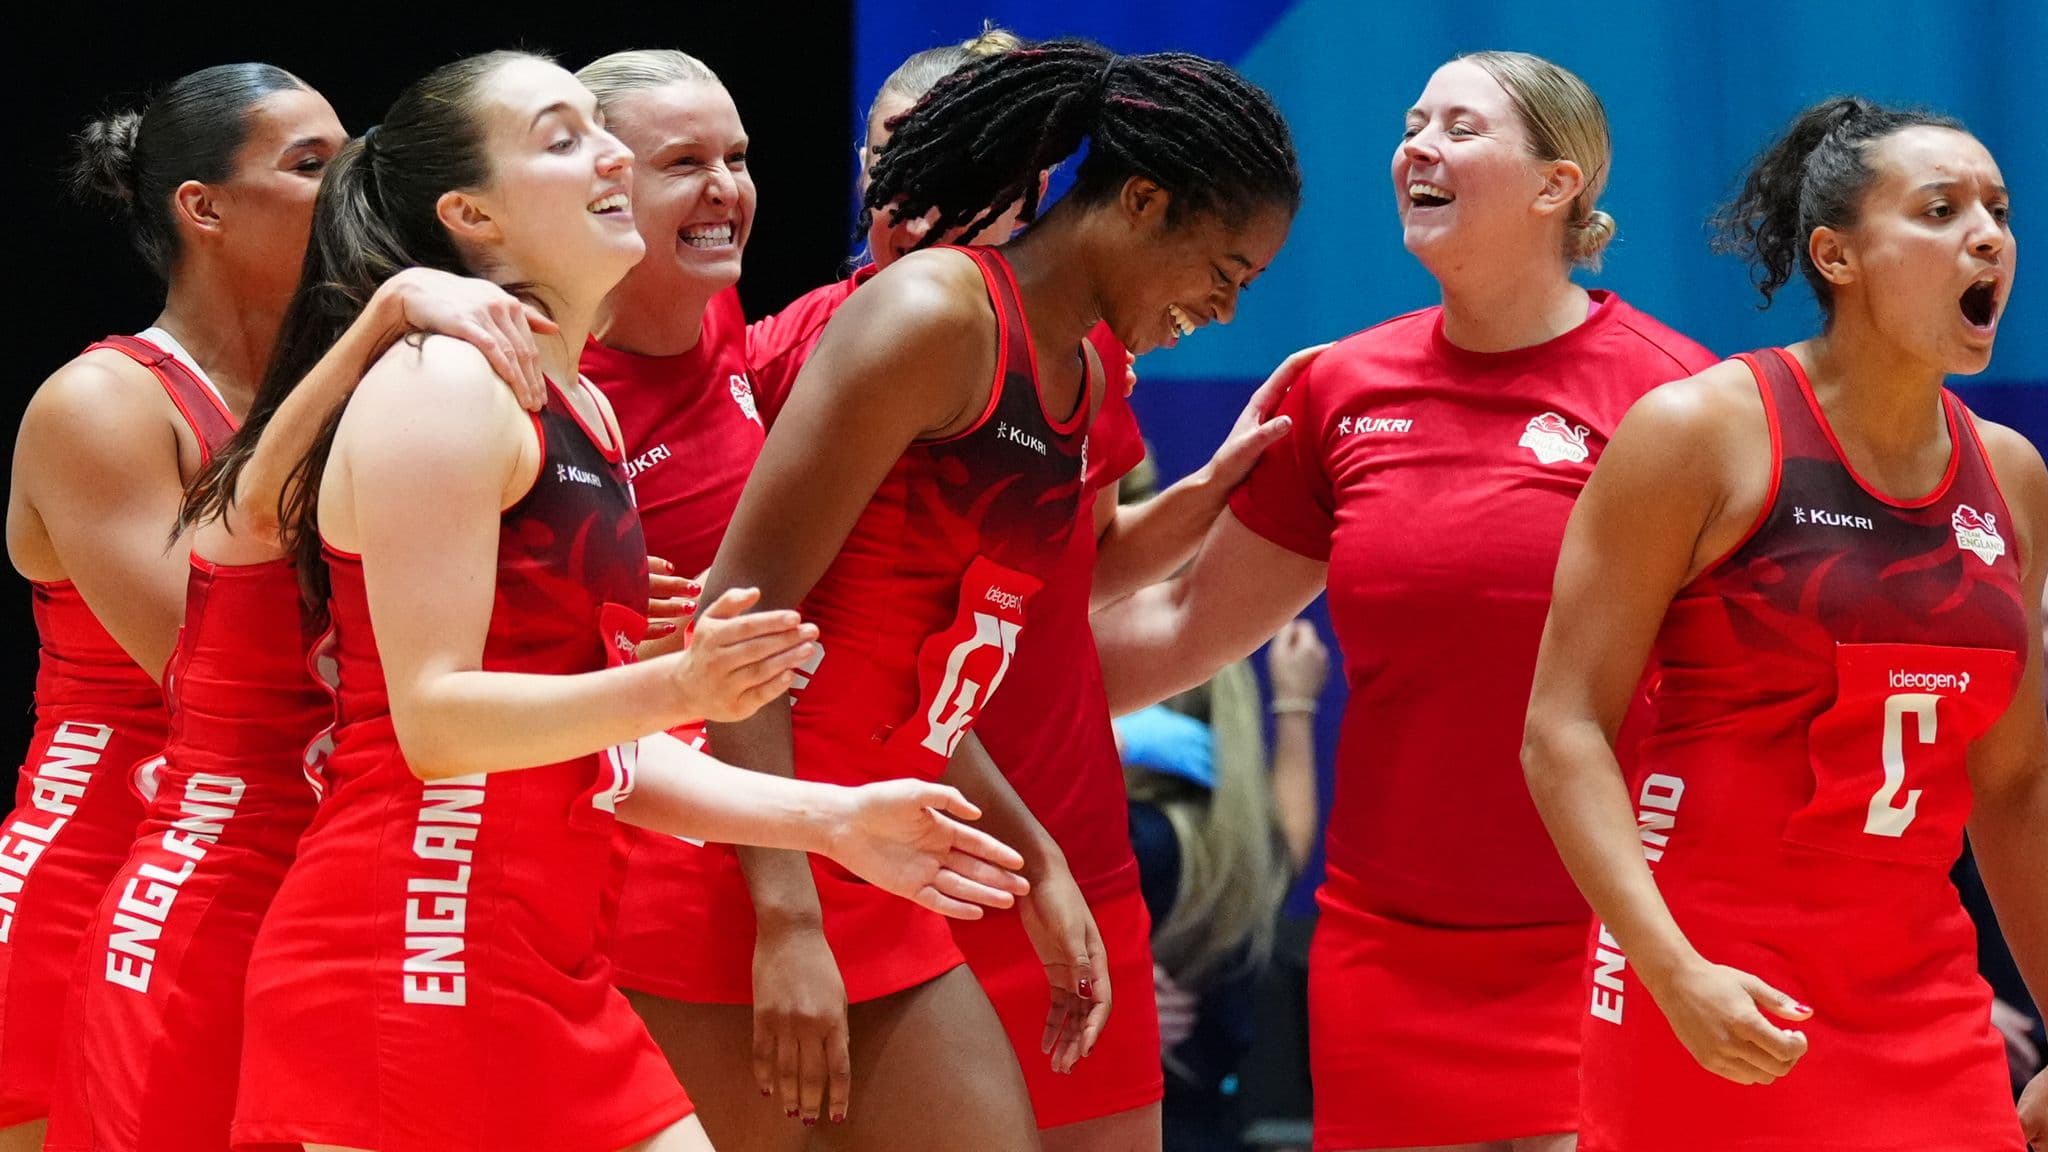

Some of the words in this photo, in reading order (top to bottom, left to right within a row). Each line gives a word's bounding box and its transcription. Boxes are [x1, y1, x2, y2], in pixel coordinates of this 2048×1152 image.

[1354, 417, 1413, 434] KUKRI
[1009, 426, 1047, 456] KUKRI
[628, 443, 673, 479] UKRI
[567, 465, 602, 488] KUKRI
[1810, 509, 1874, 530] KUKRI
[1889, 669, 1957, 692] Ideagen
[1863, 693, 1948, 838] C
[0, 721, 114, 944] NGLAND
[105, 772, 247, 994] ENGLAND
